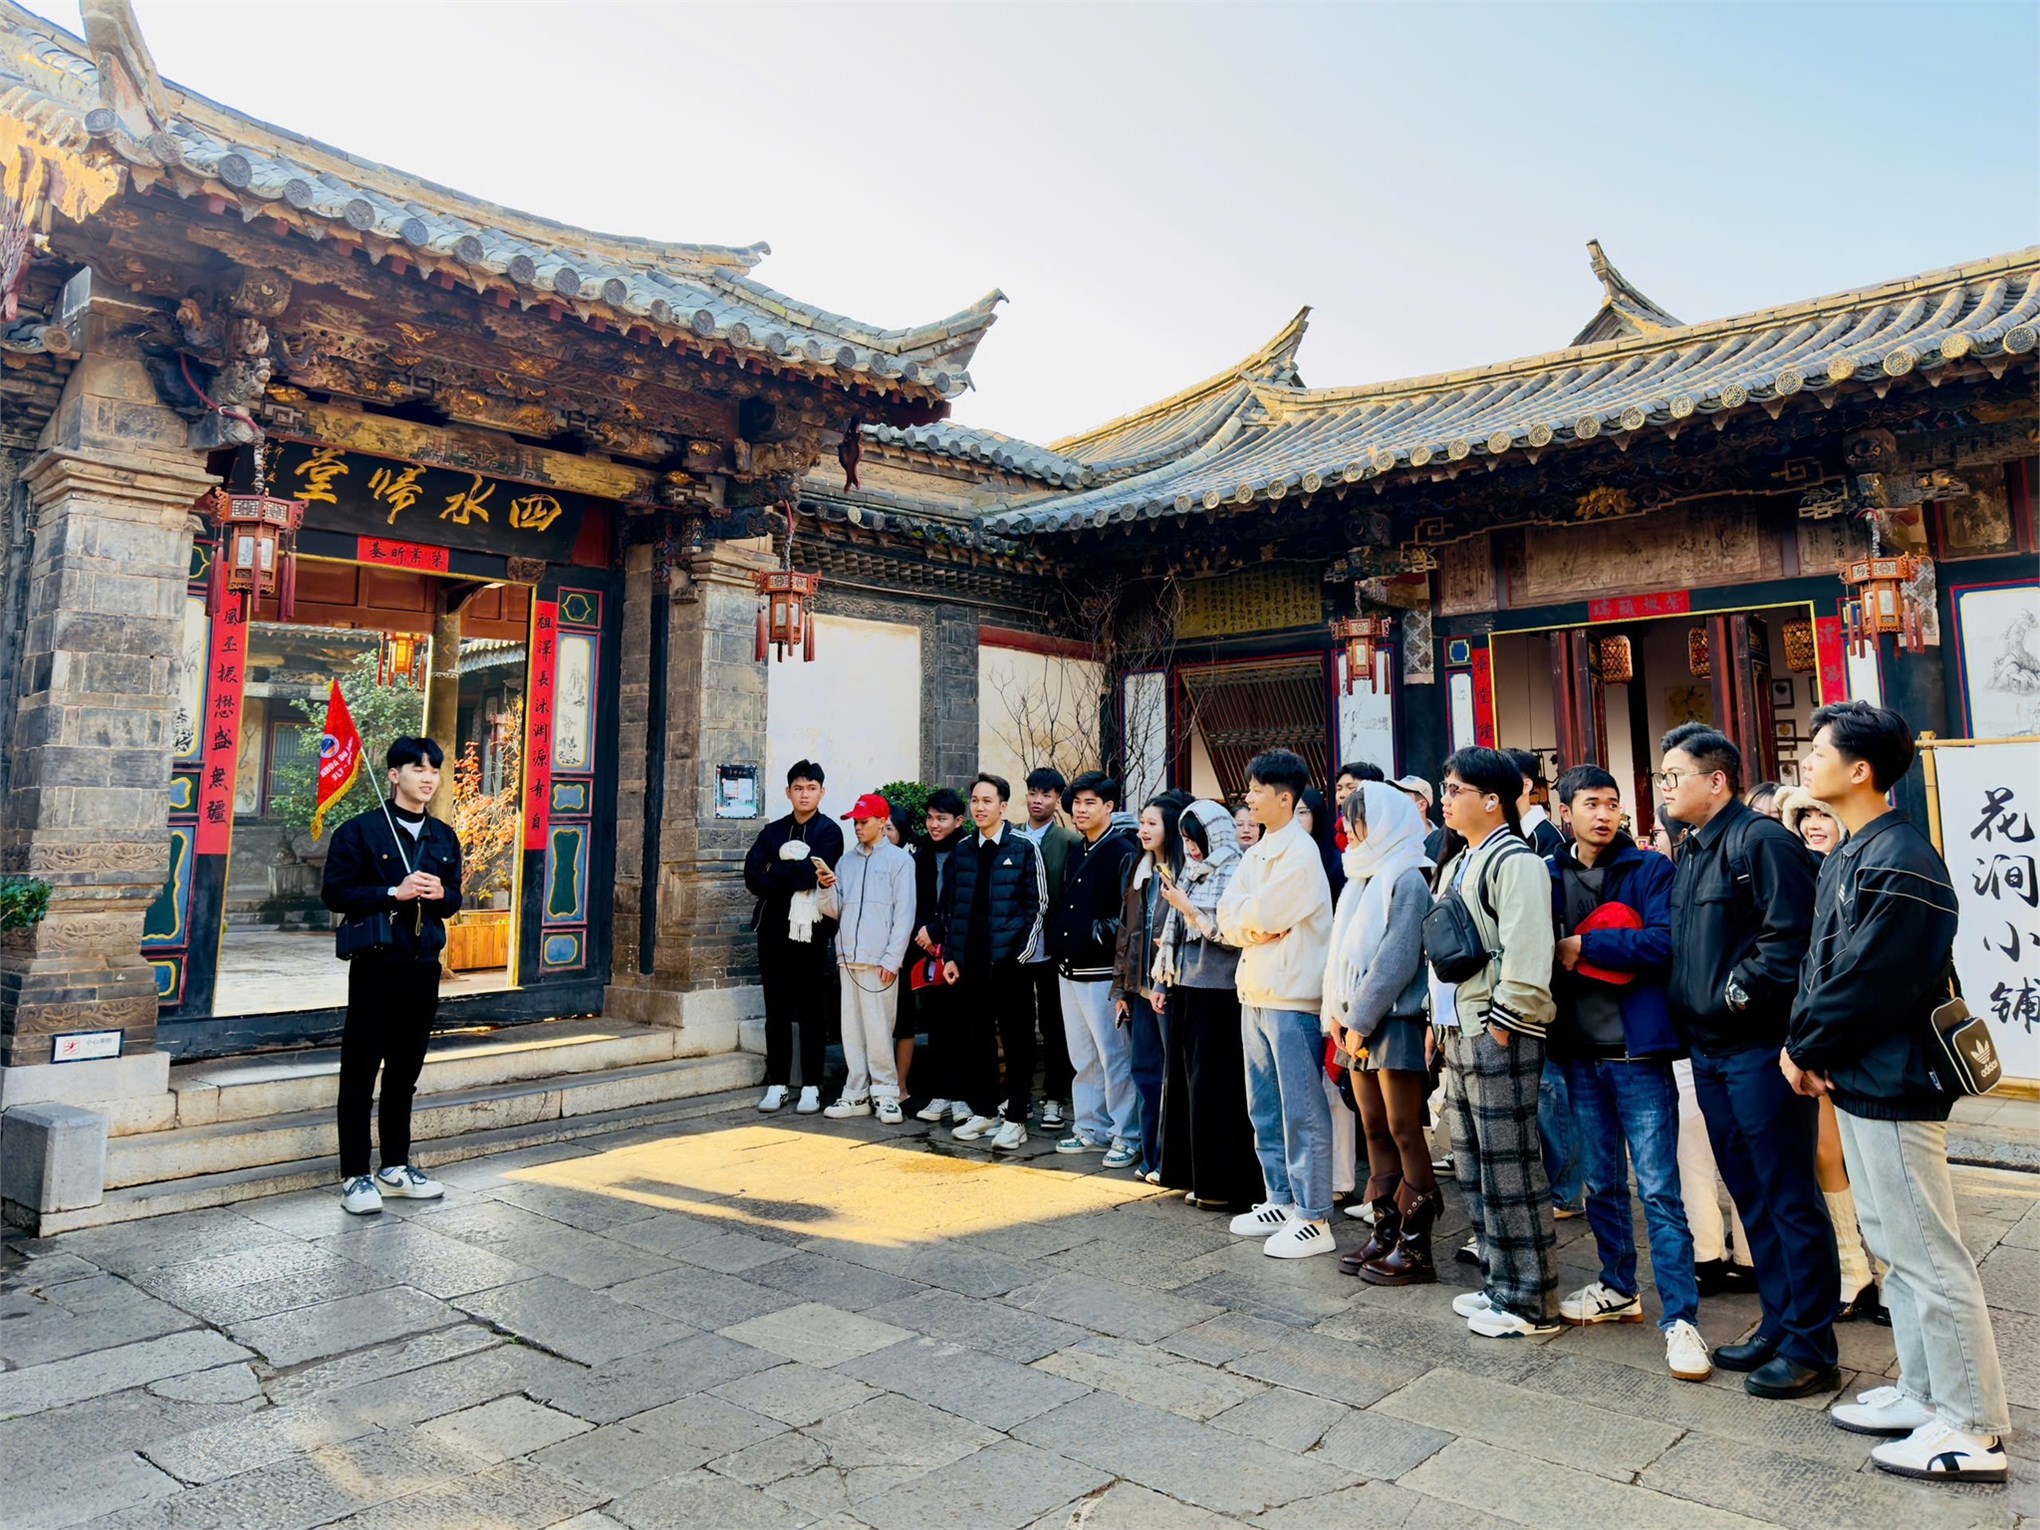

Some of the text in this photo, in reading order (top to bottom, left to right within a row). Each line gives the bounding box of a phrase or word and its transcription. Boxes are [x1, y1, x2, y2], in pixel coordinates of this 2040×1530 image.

[206, 588, 241, 828] 風丕振懋盛無疆
[1981, 1059, 1999, 1078] adidas
